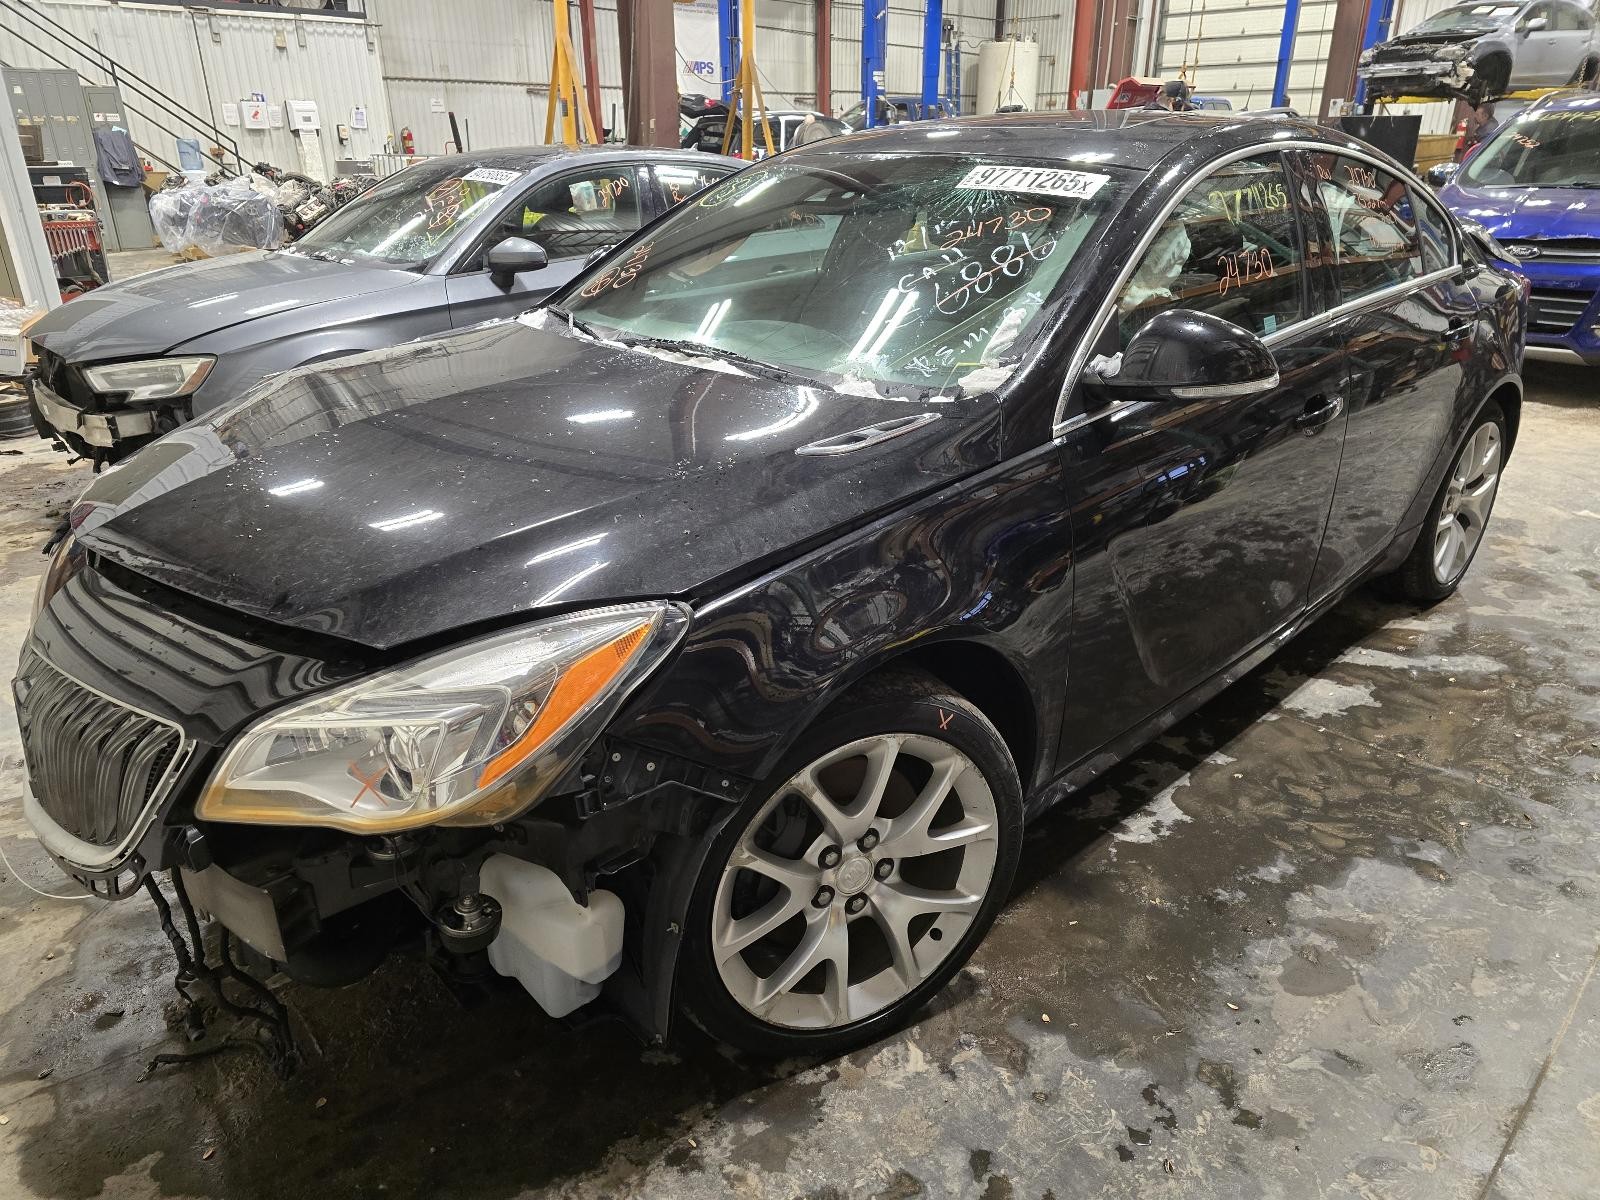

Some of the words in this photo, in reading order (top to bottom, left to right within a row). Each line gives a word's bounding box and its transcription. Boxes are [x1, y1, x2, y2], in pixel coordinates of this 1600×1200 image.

[693, 60, 714, 75] APS
[939, 207, 1052, 251] 24730
[1217, 248, 1275, 297] 24730
